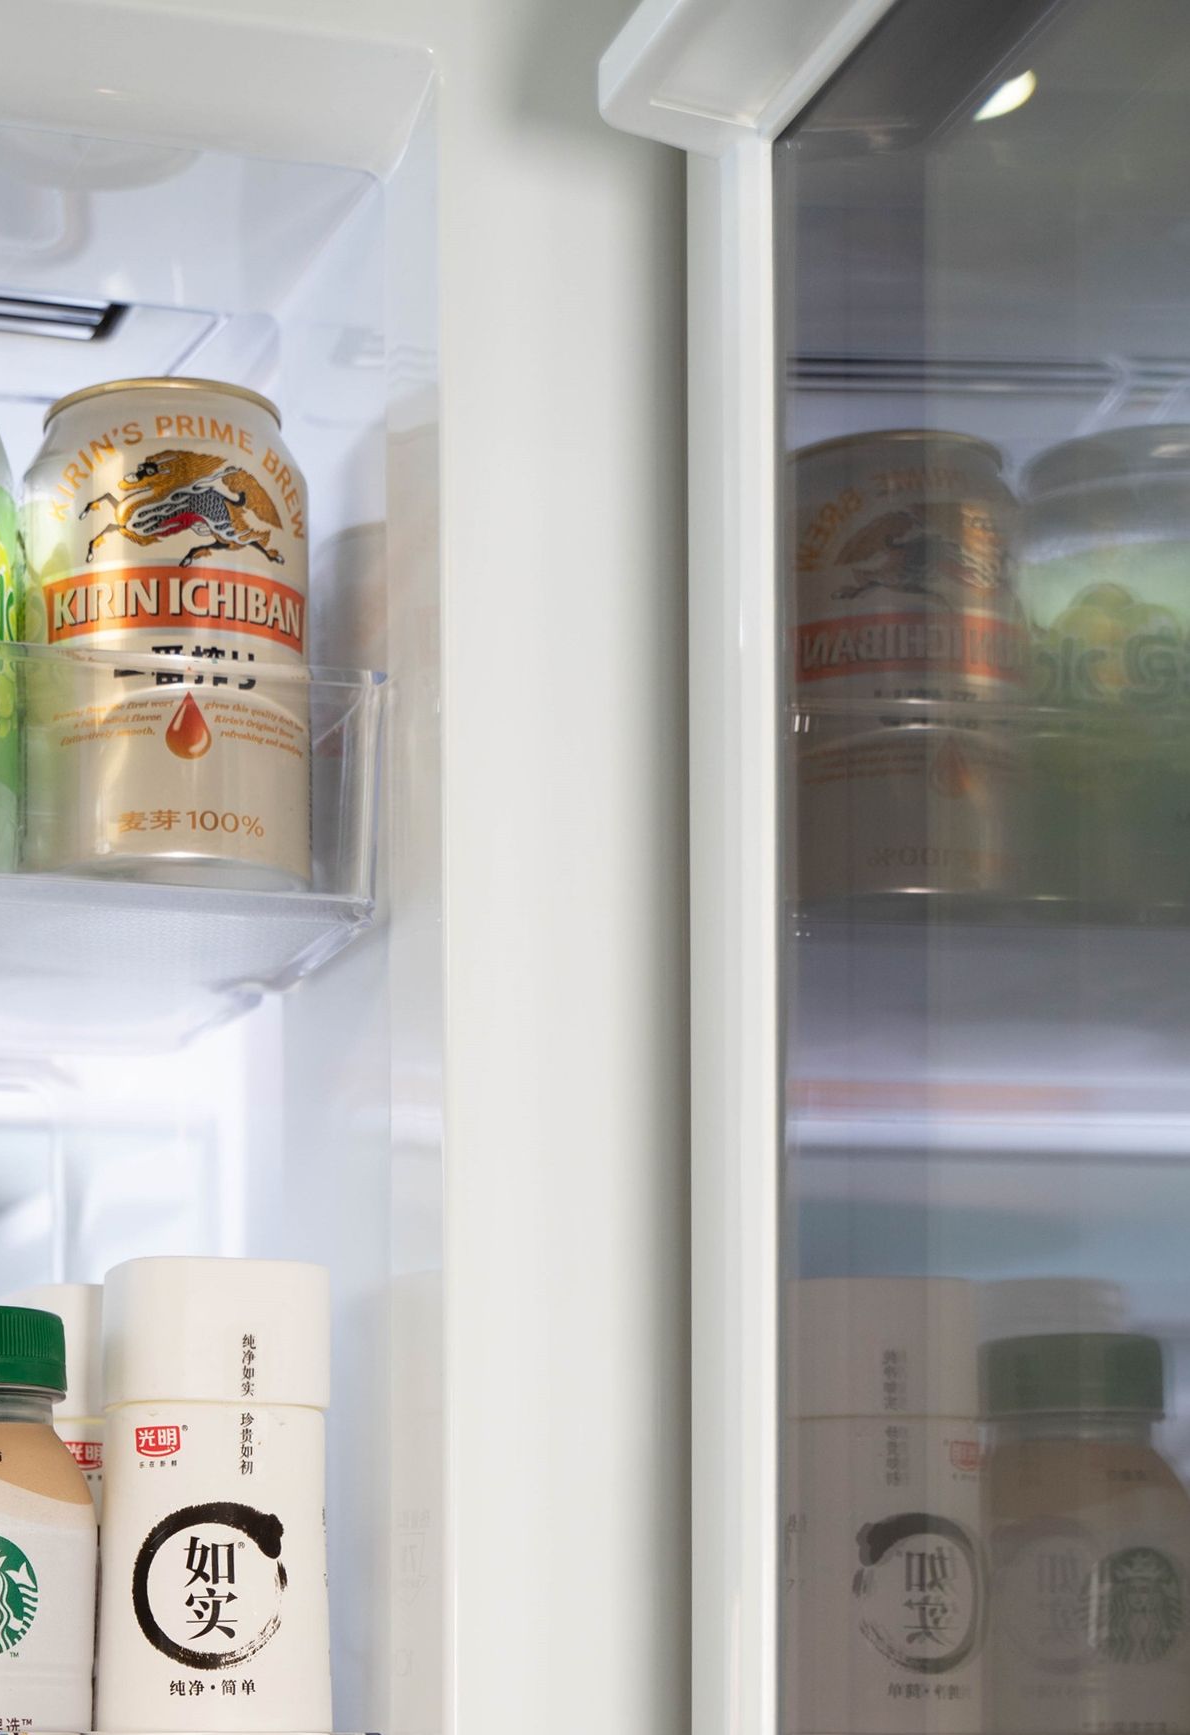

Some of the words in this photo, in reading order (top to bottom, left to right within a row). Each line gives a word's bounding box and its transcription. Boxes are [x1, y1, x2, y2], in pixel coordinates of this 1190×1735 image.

[48, 422, 144, 523] KIRIN'S
[155, 415, 254, 455] PRIME
[262, 447, 305, 540] BREW
[53, 578, 160, 631] KIRIN
[169, 577, 303, 640] ICHIBAN
[240, 1333, 257, 1398] 纯净如实
[138, 1428, 178, 1447] 光明
[238, 1412, 255, 1475] 珍贵如初
[183, 1536, 238, 1641] 如实
[169, 1679, 256, 1697] 纯净·简单
